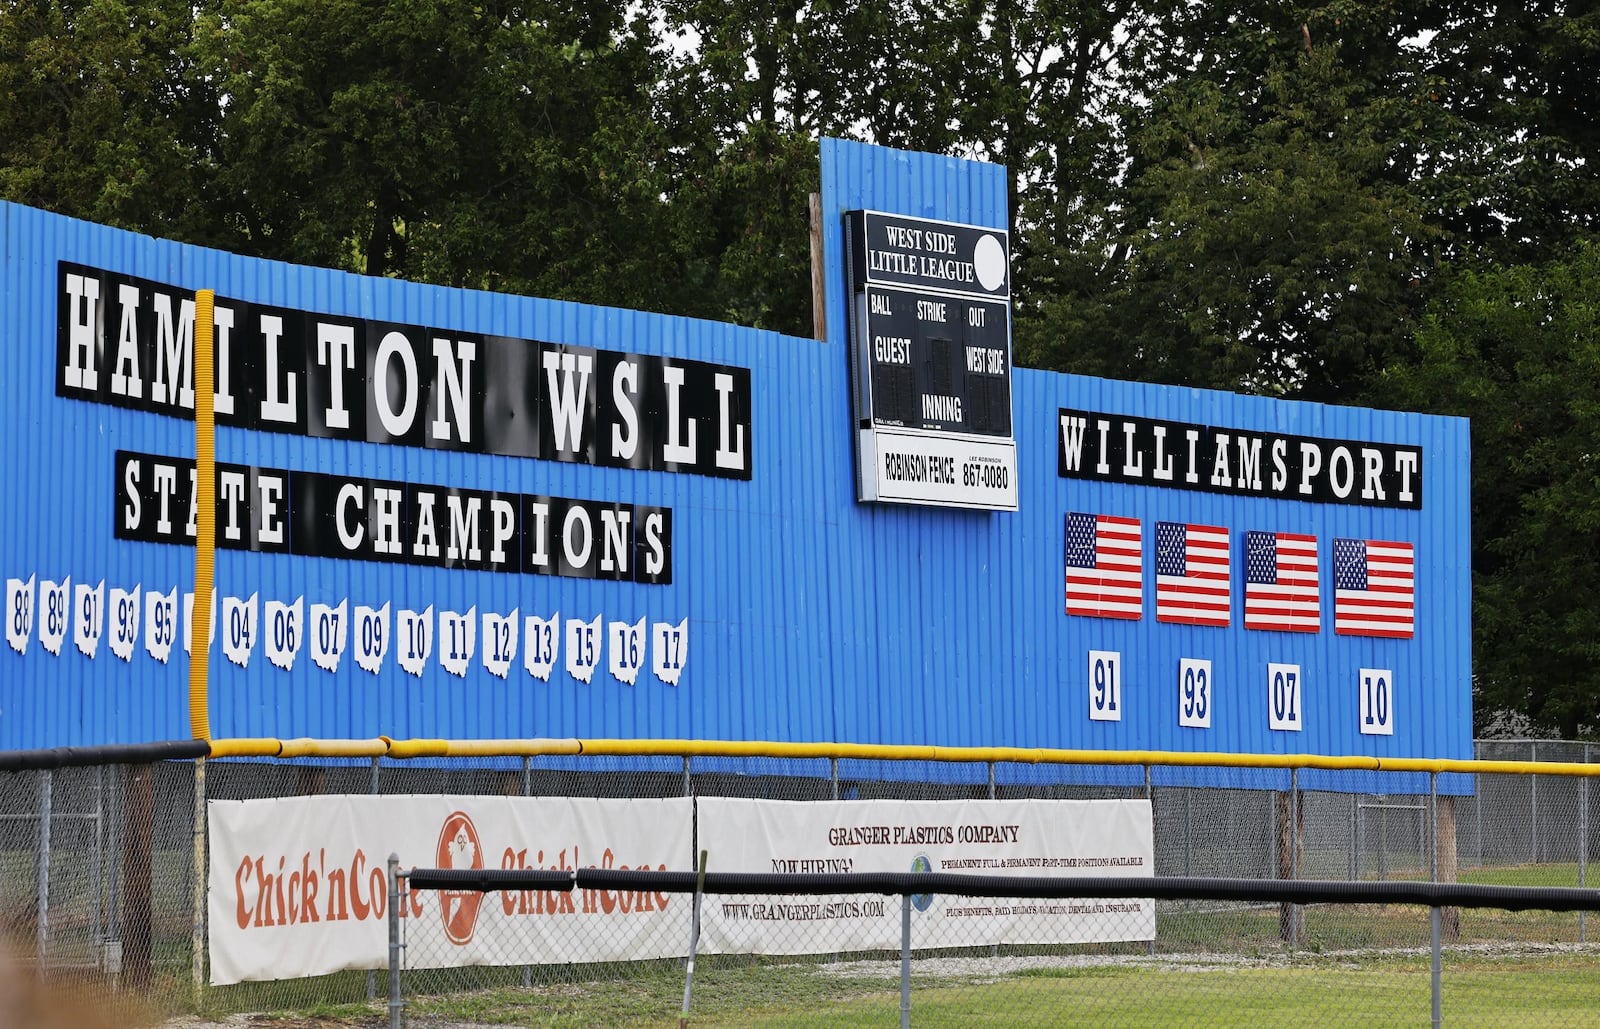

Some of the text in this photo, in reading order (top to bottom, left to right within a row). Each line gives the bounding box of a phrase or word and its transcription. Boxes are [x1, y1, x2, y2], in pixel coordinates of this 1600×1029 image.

[885, 225, 956, 254] WEST SIDE
[870, 250, 974, 282] LITTLE LEAGUE
[871, 294, 892, 315] BALL
[917, 300, 946, 322] STRIKE
[968, 307, 985, 327] OUT
[875, 335, 912, 364] GUEST
[966, 346, 1004, 375] WEST SIDE
[65, 273, 744, 470] HAMILTON WSLL
[922, 393, 962, 422] INNING
[885, 452, 955, 485] ROBINSON FENCE
[963, 463, 1008, 490] 867-0080
[1060, 415, 1417, 502] WILLIAMSPORT
[336, 483, 664, 575] CHAMPIONS
[14, 590, 29, 636] 88
[48, 590, 64, 636] 89
[83, 594, 97, 639] 91
[118, 597, 134, 644] 93
[155, 601, 171, 645] 95
[230, 606, 250, 649] 04
[274, 610, 295, 653] 06
[319, 613, 338, 655] 07
[362, 615, 382, 657] 09
[407, 618, 425, 660] 10
[450, 619, 467, 660] 11
[493, 622, 510, 662] 12
[534, 624, 551, 665] 13
[576, 627, 593, 667] 15
[619, 630, 638, 669] 16
[663, 631, 680, 669] 17
[1094, 658, 1116, 711] 91
[1184, 667, 1207, 719] 93
[1274, 671, 1296, 721] 07
[1365, 677, 1387, 726] 10
[828, 825, 1020, 846] GRANGER PLASTICS COMPANY
[771, 858, 798, 873] NOW
[983, 859, 1000, 869] FULL
[1001, 859, 1006, 868] &
[1042, 858, 1077, 868] PART-TIME
[1109, 857, 1143, 867] AVAILABLE
[721, 901, 885, 921] WWW.GRANGERPLASTICS.COM
[946, 908, 962, 917] PLUS
[995, 906, 1011, 916] PAID
[1105, 903, 1141, 913] INSURANCE
